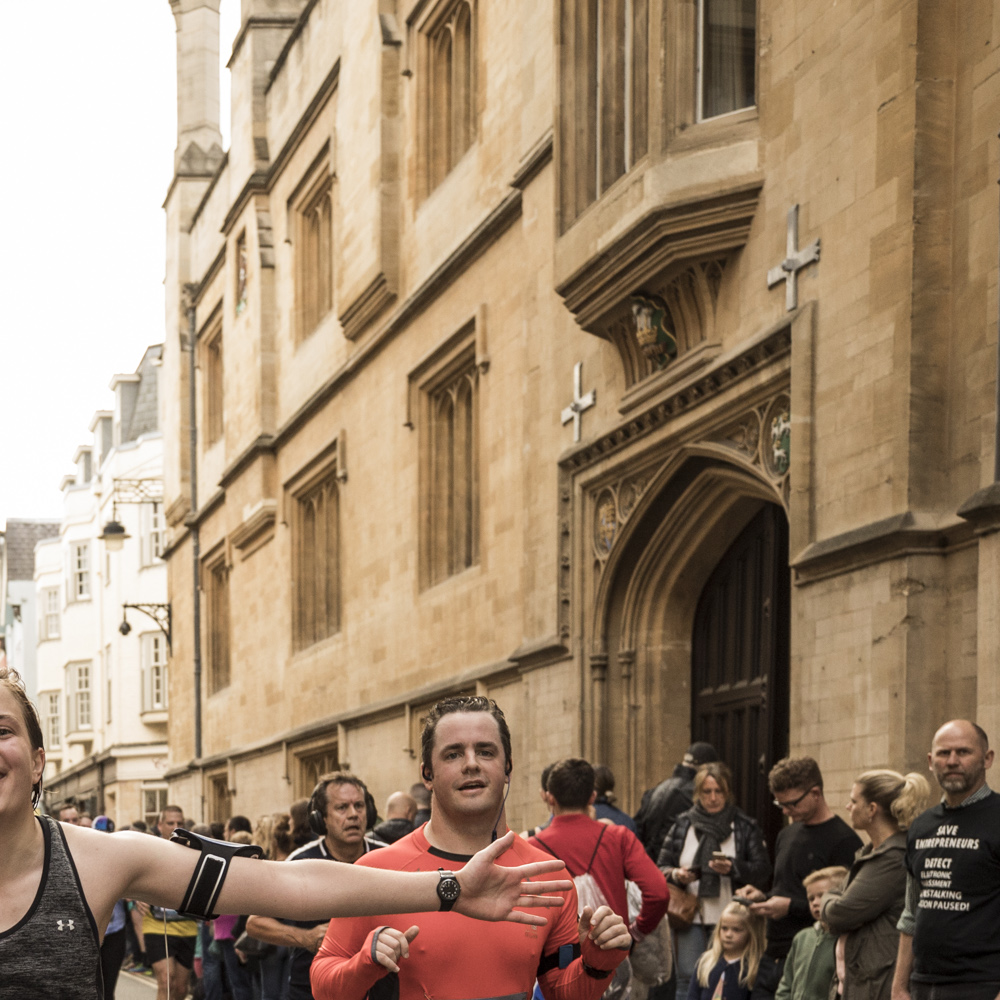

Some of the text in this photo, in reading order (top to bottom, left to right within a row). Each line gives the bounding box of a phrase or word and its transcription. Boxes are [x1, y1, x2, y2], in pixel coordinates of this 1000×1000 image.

[936, 825, 958, 836] SAVE
[915, 837, 979, 850] ENTREPRENEURS
[924, 858, 952, 868] DETECT
[933, 900, 970, 911] PAUSED!
